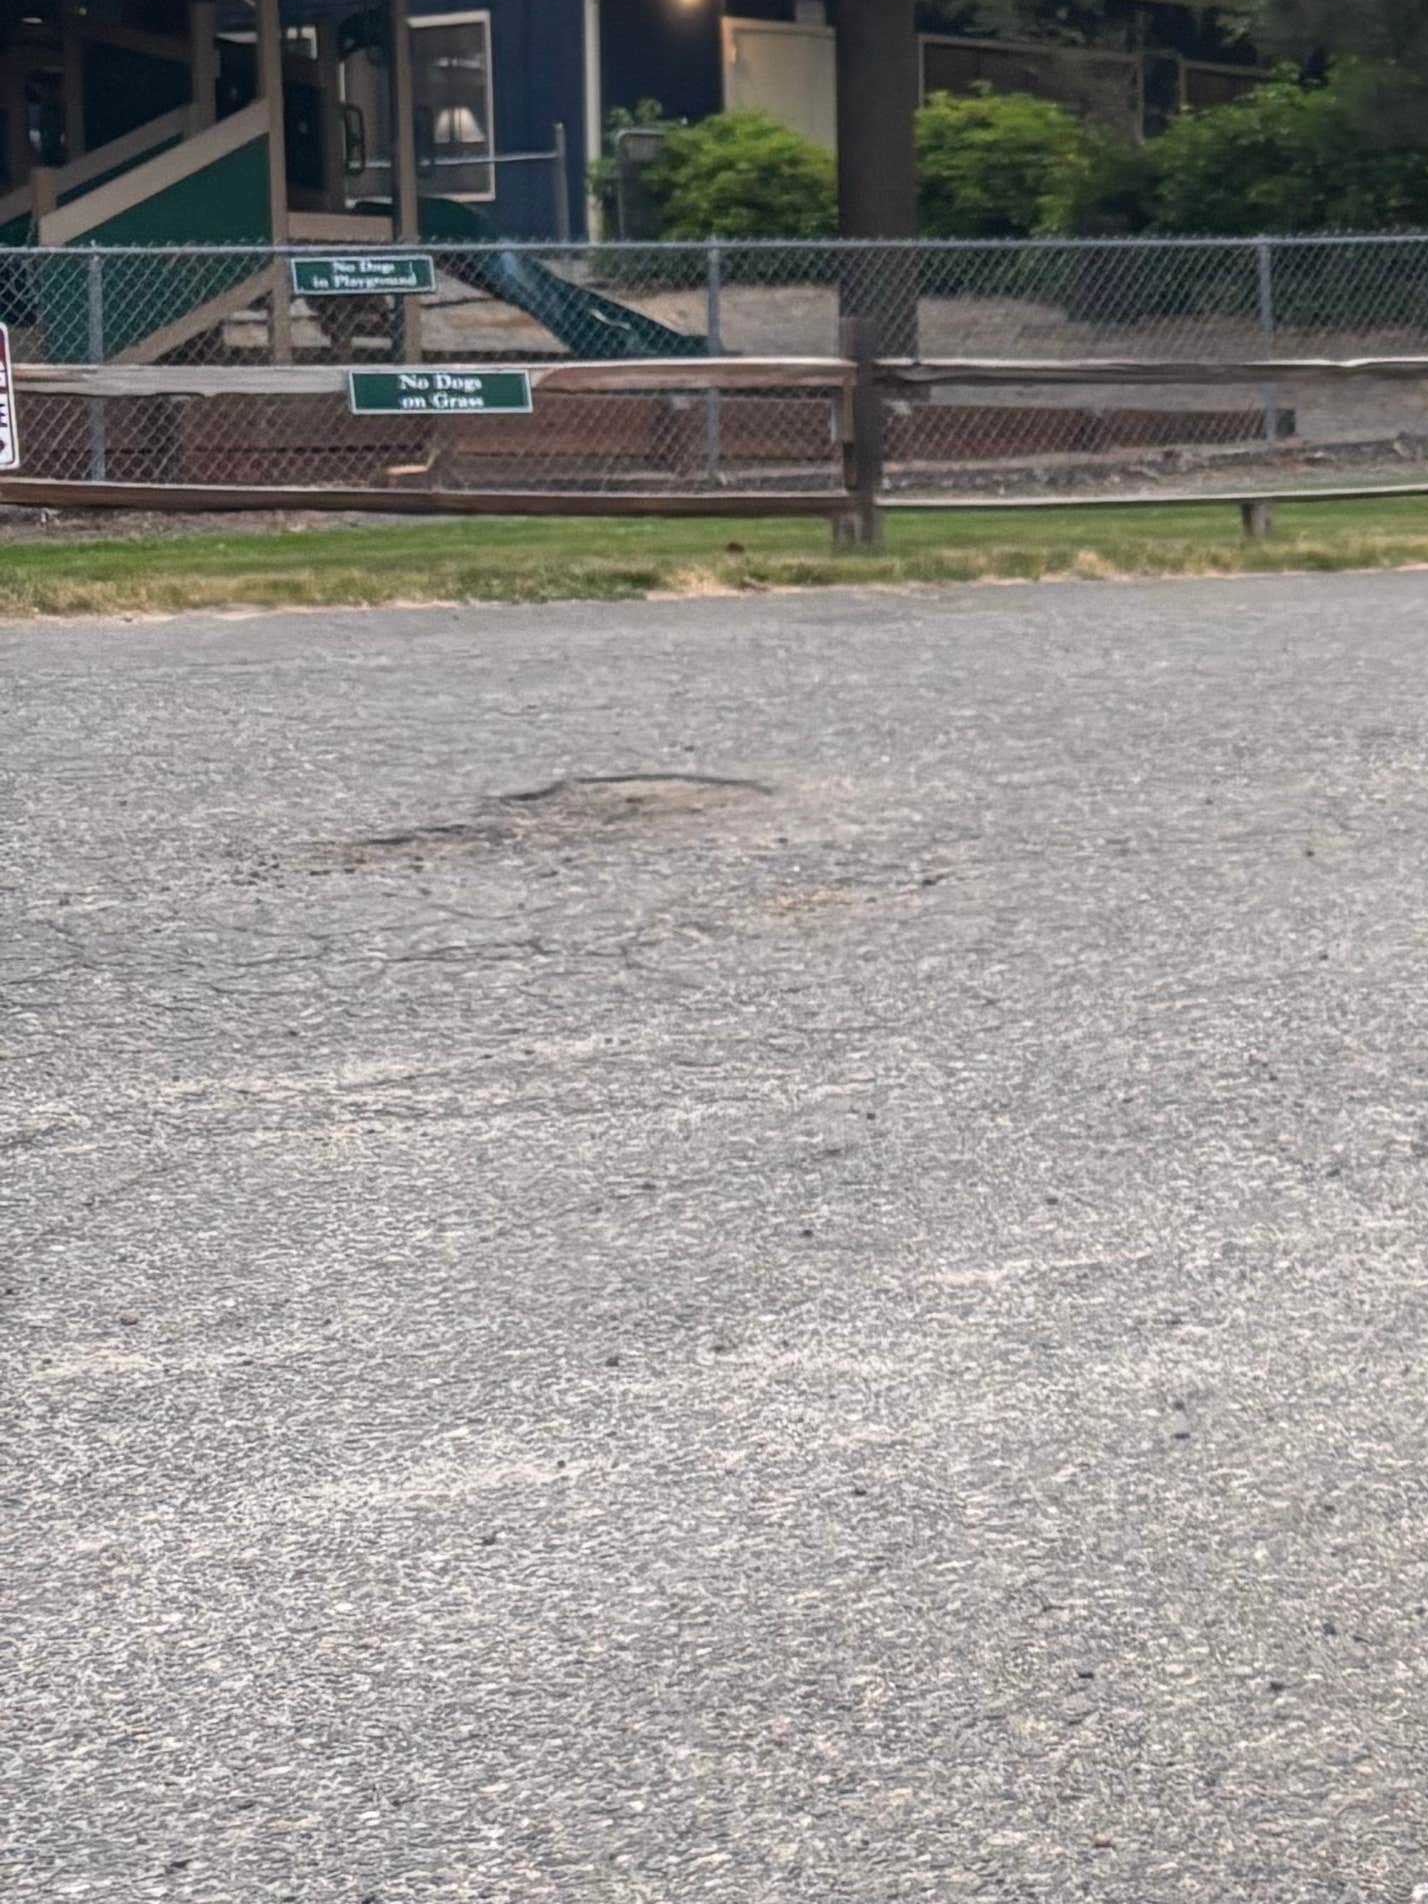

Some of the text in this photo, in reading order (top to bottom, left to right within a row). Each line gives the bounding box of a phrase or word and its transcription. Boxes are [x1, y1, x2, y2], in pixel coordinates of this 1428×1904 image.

[332, 261, 356, 273] No
[399, 374, 482, 393] No Dogs
[401, 391, 484, 409] on Grass
